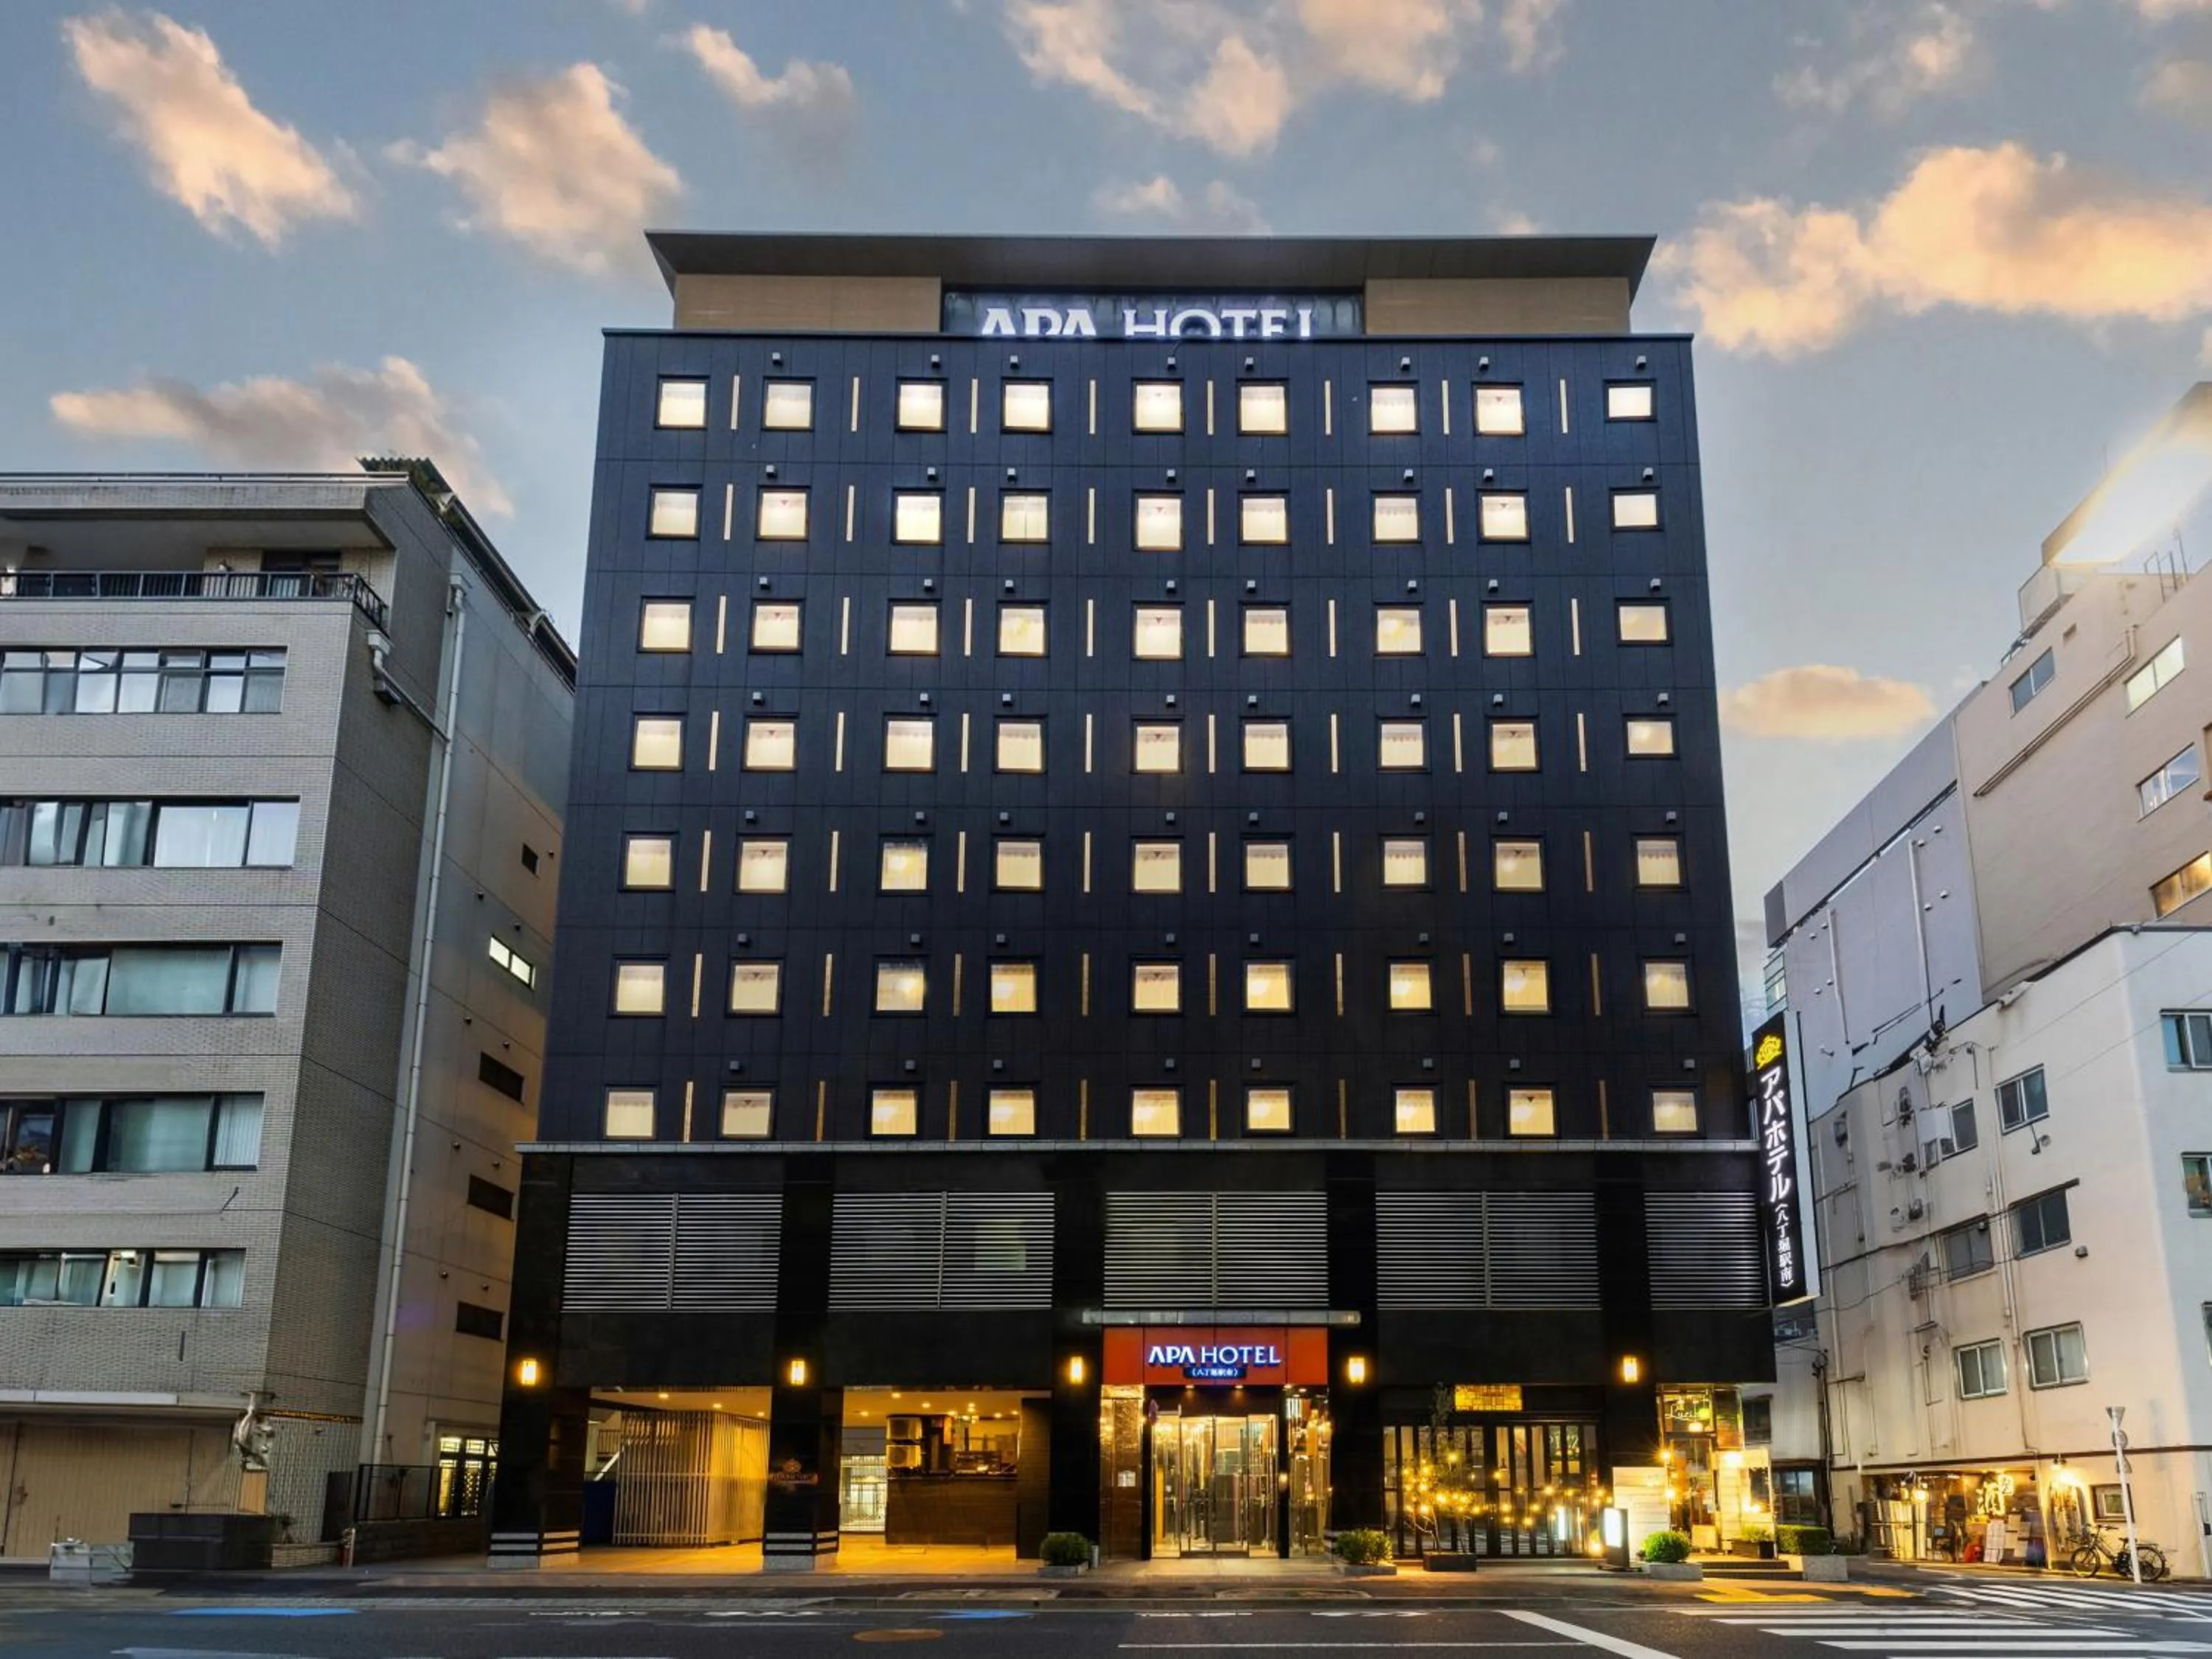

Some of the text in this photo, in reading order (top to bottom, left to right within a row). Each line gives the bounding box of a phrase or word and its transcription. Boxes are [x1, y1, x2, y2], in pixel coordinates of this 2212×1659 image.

[981, 307, 1097, 336] APA
[1759, 1065, 1792, 1203] アパホテル
[1148, 1346, 1281, 1364] APA HOTEL
